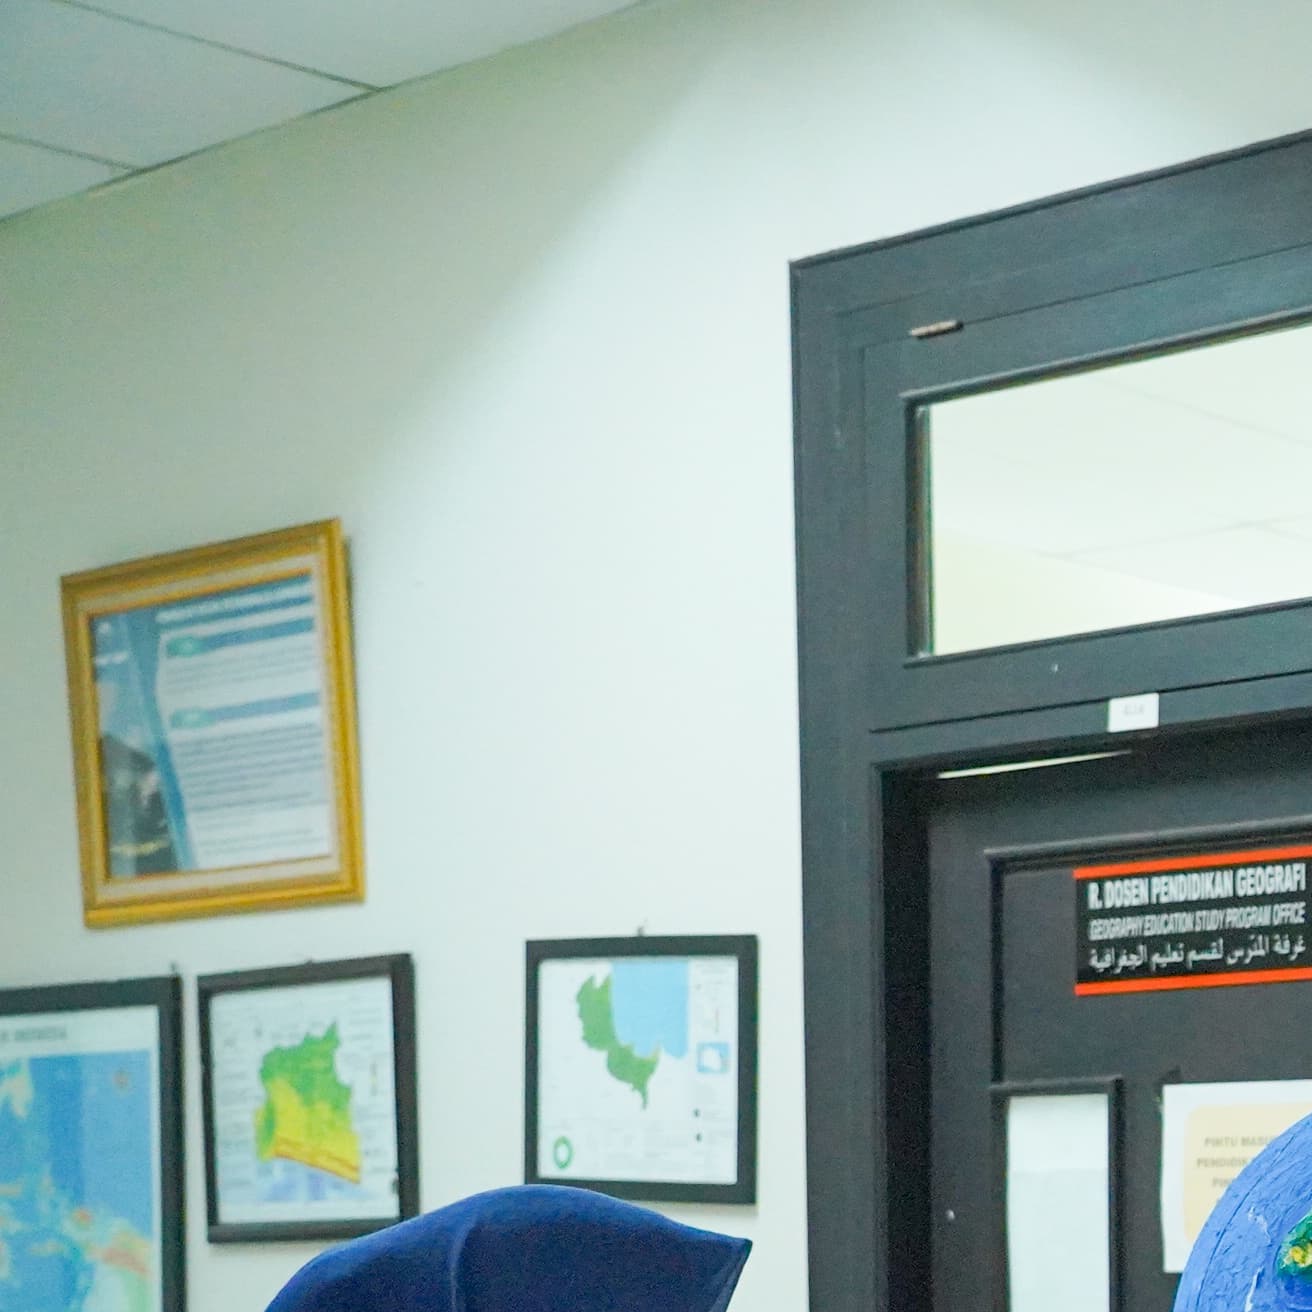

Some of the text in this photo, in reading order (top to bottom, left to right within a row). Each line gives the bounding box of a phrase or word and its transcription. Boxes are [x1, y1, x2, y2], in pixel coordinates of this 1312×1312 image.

[1088, 862, 1306, 909] R. DOSEN PENDIDIKAN GEOGRAFI
[1088, 901, 1305, 941] GEOGRAPHY EDUCATION STUDY PROGRAM OFFICE
